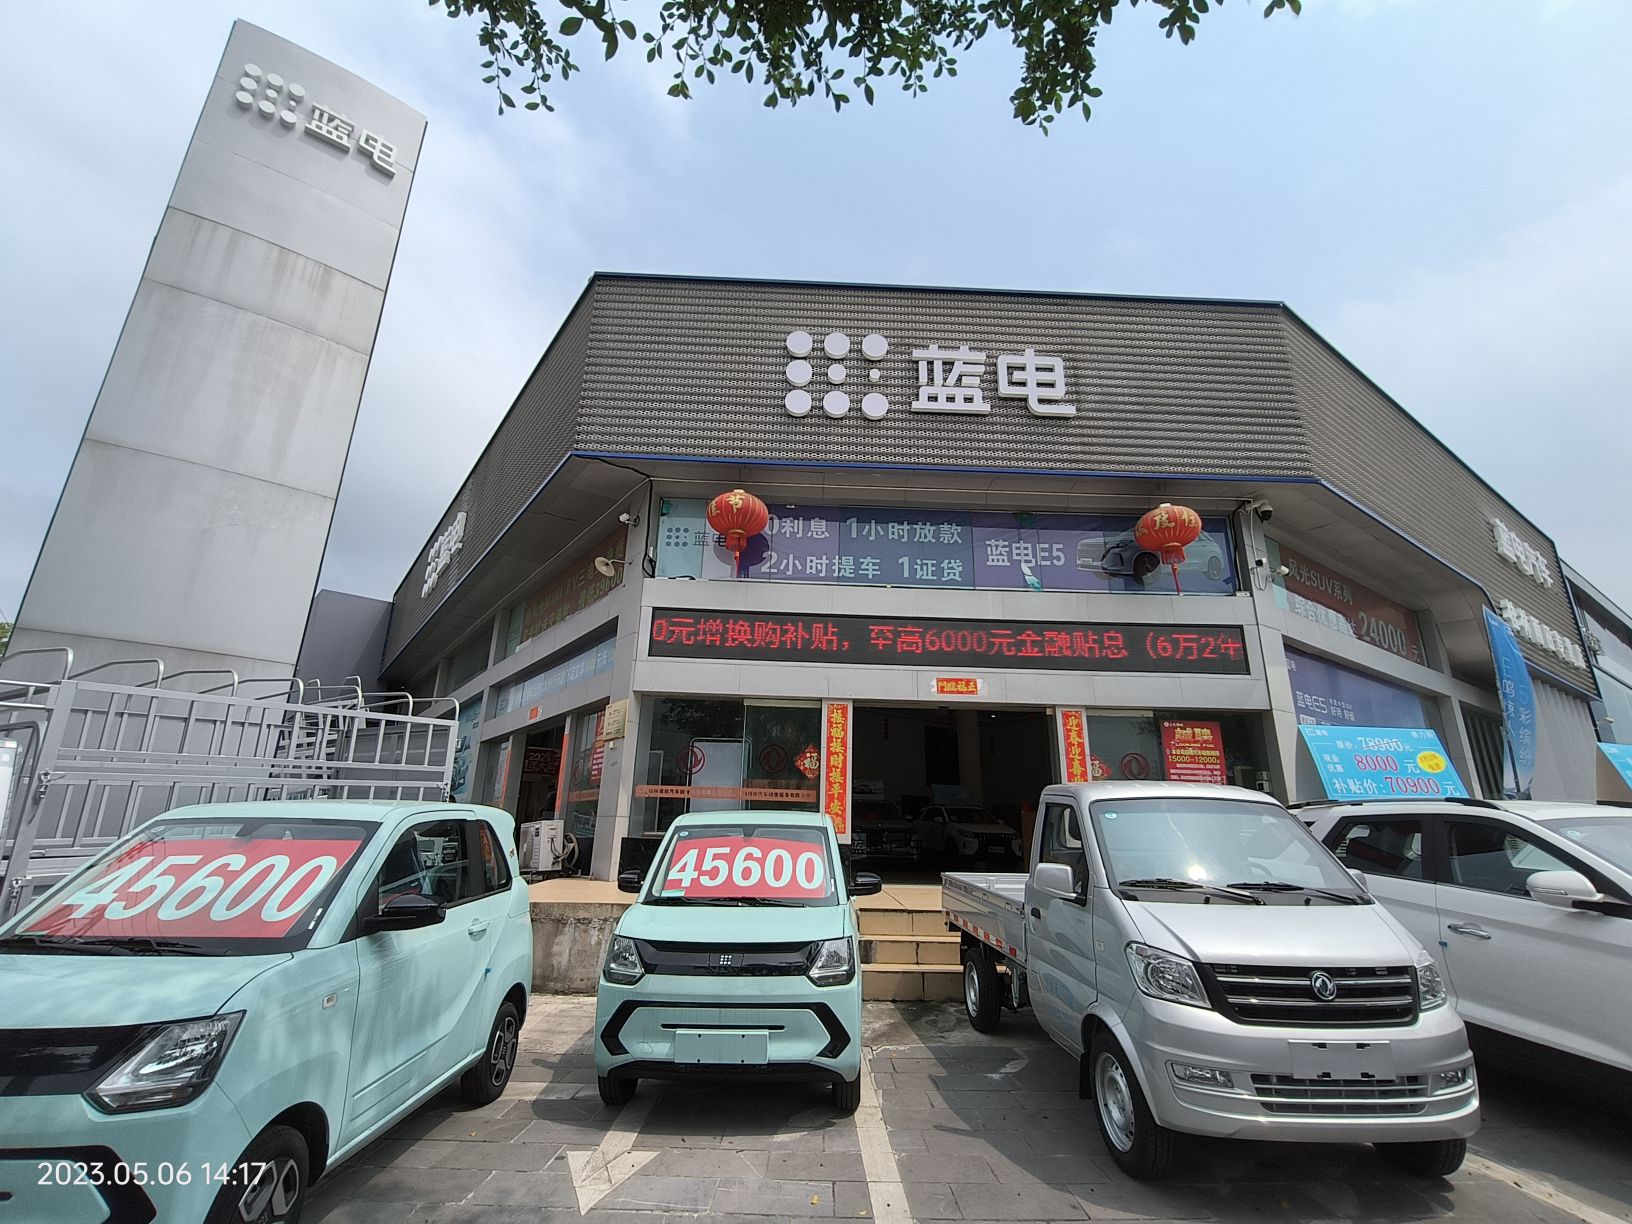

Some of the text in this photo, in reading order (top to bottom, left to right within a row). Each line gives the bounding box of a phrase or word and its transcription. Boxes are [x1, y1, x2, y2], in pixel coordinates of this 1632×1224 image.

[304, 102, 396, 177] 蓝电
[911, 344, 1077, 418] 蓝电
[766, 514, 963, 544] 0利息 1小时放款
[760, 551, 963, 581] 2小时提车 1证贷
[985, 538, 1066, 567] 蓝电E5
[61, 853, 338, 923] 45600
[666, 846, 824, 890] 45600
